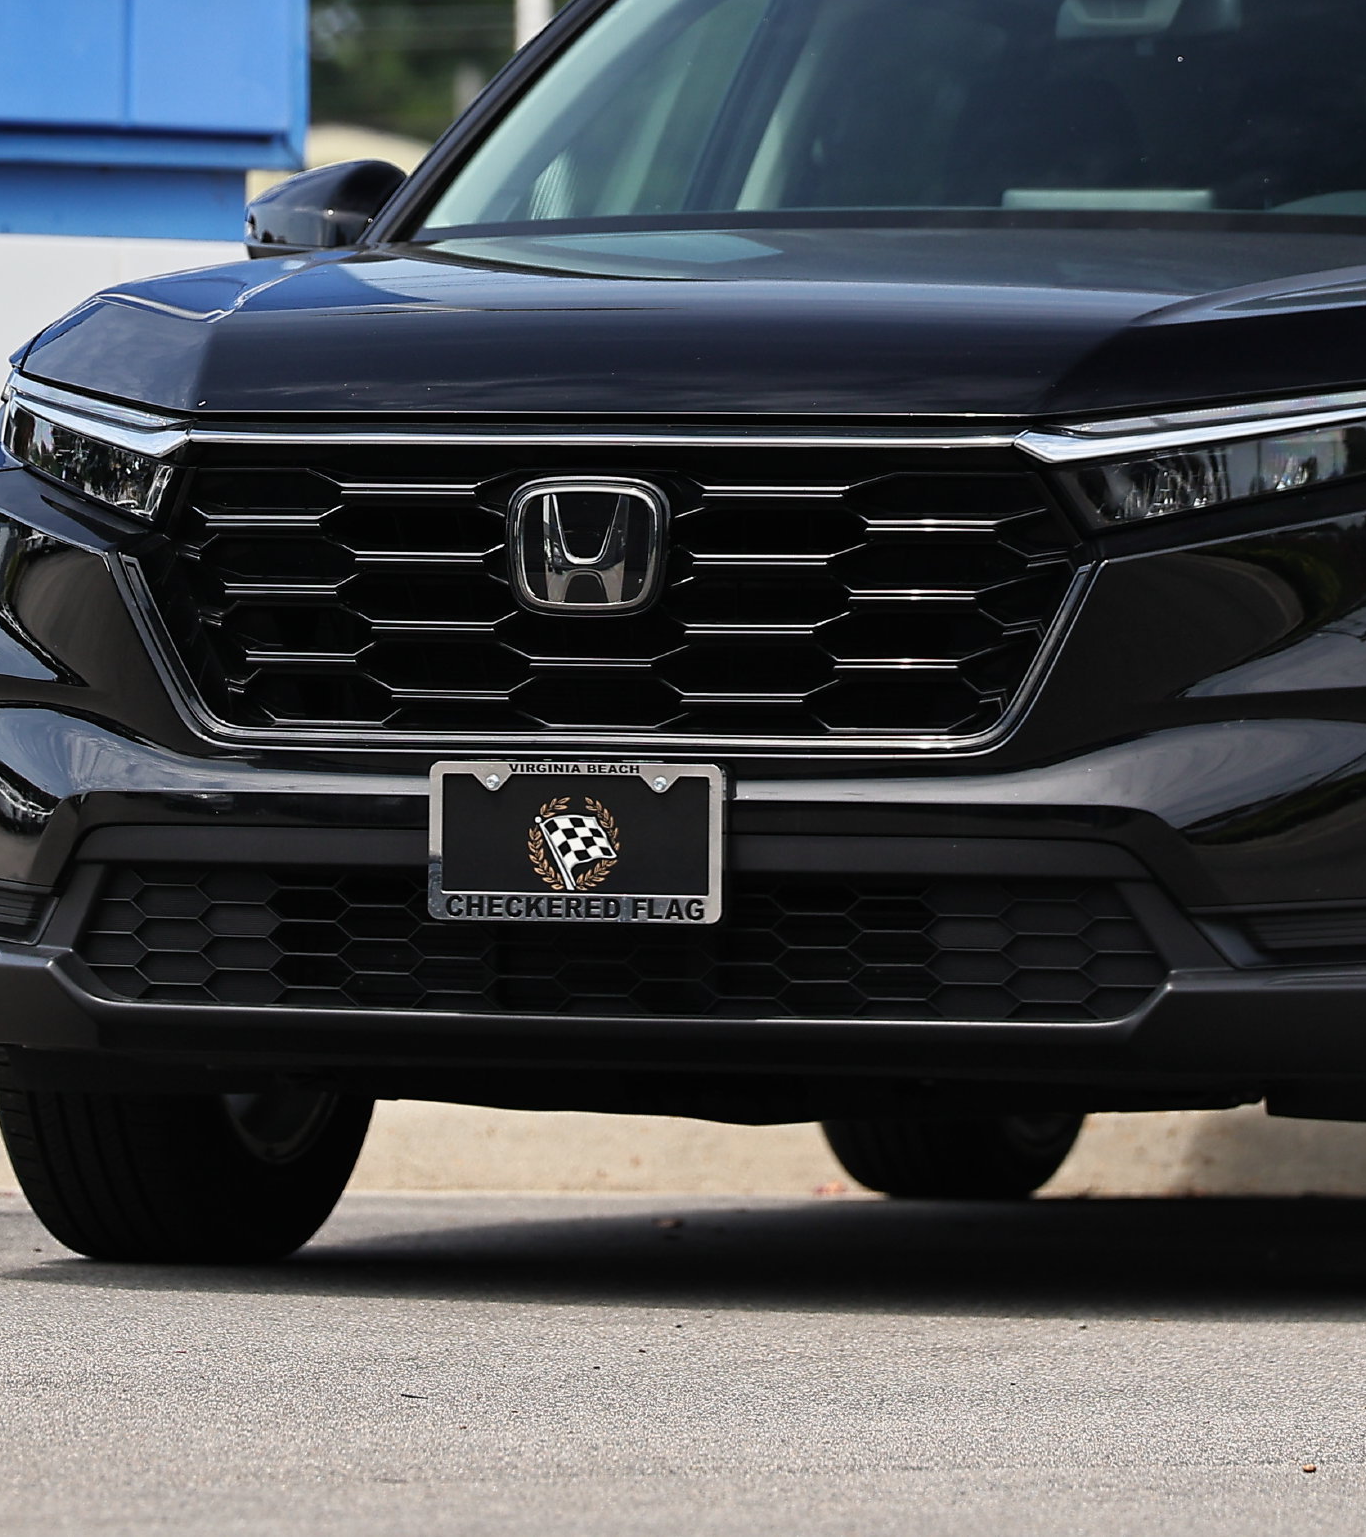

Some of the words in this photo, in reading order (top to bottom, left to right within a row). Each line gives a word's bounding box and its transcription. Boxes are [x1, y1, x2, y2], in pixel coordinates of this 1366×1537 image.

[508, 763, 582, 773] VIRGINIA
[587, 764, 640, 774] BEACH
[445, 895, 621, 919] CHECKERED
[631, 898, 705, 921] FLAG
